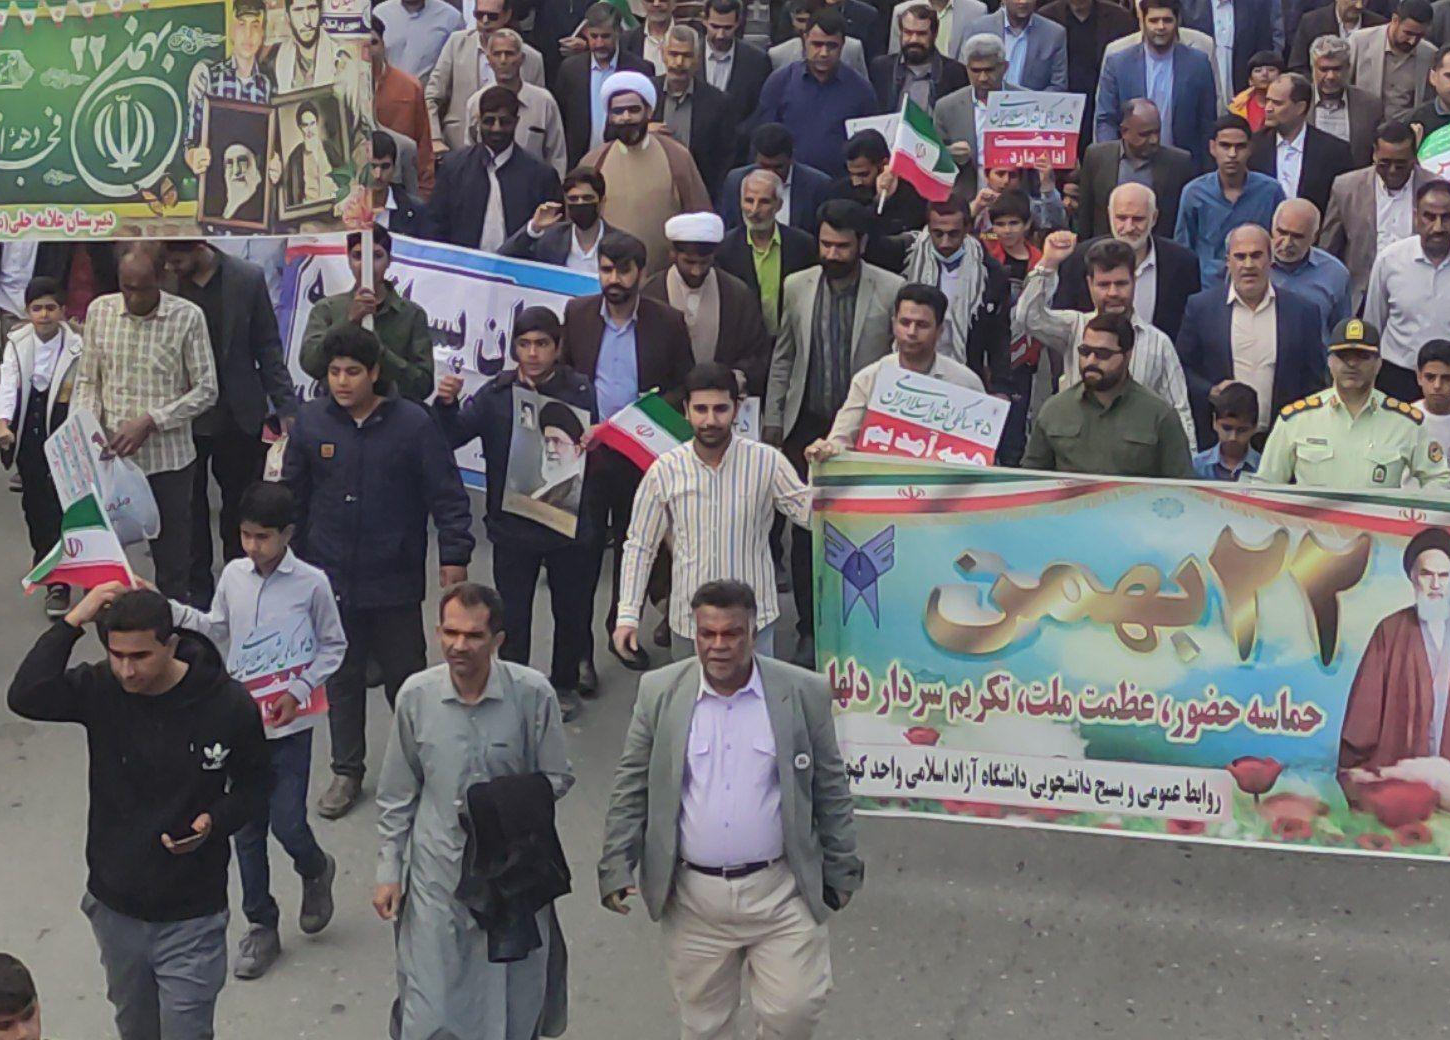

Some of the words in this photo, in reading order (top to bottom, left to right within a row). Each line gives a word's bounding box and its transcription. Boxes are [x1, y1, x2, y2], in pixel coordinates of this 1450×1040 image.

[70, 34, 107, 72] ۲۲
[1039, 97, 1066, 129] سالگی
[1060, 112, 1075, 125] ۴۵
[994, 132, 1066, 147] نهضت
[8, 211, 32, 234] حلی
[66, 210, 114, 234] دبیرستان
[880, 391, 913, 411] ایران
[896, 375, 949, 413] اسلامی
[901, 401, 954, 426] انقلاب
[942, 398, 983, 431] سالگی
[974, 418, 992, 436] ۴۵
[862, 425, 940, 458] آمدیم
[923, 547, 1208, 662] بهمن
[1209, 525, 1372, 667] ۲۲
[285, 617, 306, 661] سالگی
[299, 636, 314, 652] ۴۵
[877, 664, 944, 720] سردار
[949, 674, 1011, 723] تکریم
[1017, 675, 1073, 718] ملت،
[1077, 680, 1155, 725] عظمت
[1160, 687, 1241, 739] حضور،
[1248, 687, 1322, 732] حماسه
[872, 759, 903, 789] واحد
[905, 757, 949, 790] اسلامی
[951, 757, 980, 794] آزاد
[981, 763, 1028, 791] دانشگاه
[1029, 768, 1092, 801] دانشجویی
[1095, 779, 1125, 805] بسیج
[1126, 792, 1135, 808] و
[1137, 786, 1182, 811] عمومی
[1183, 777, 1222, 815] روابط
